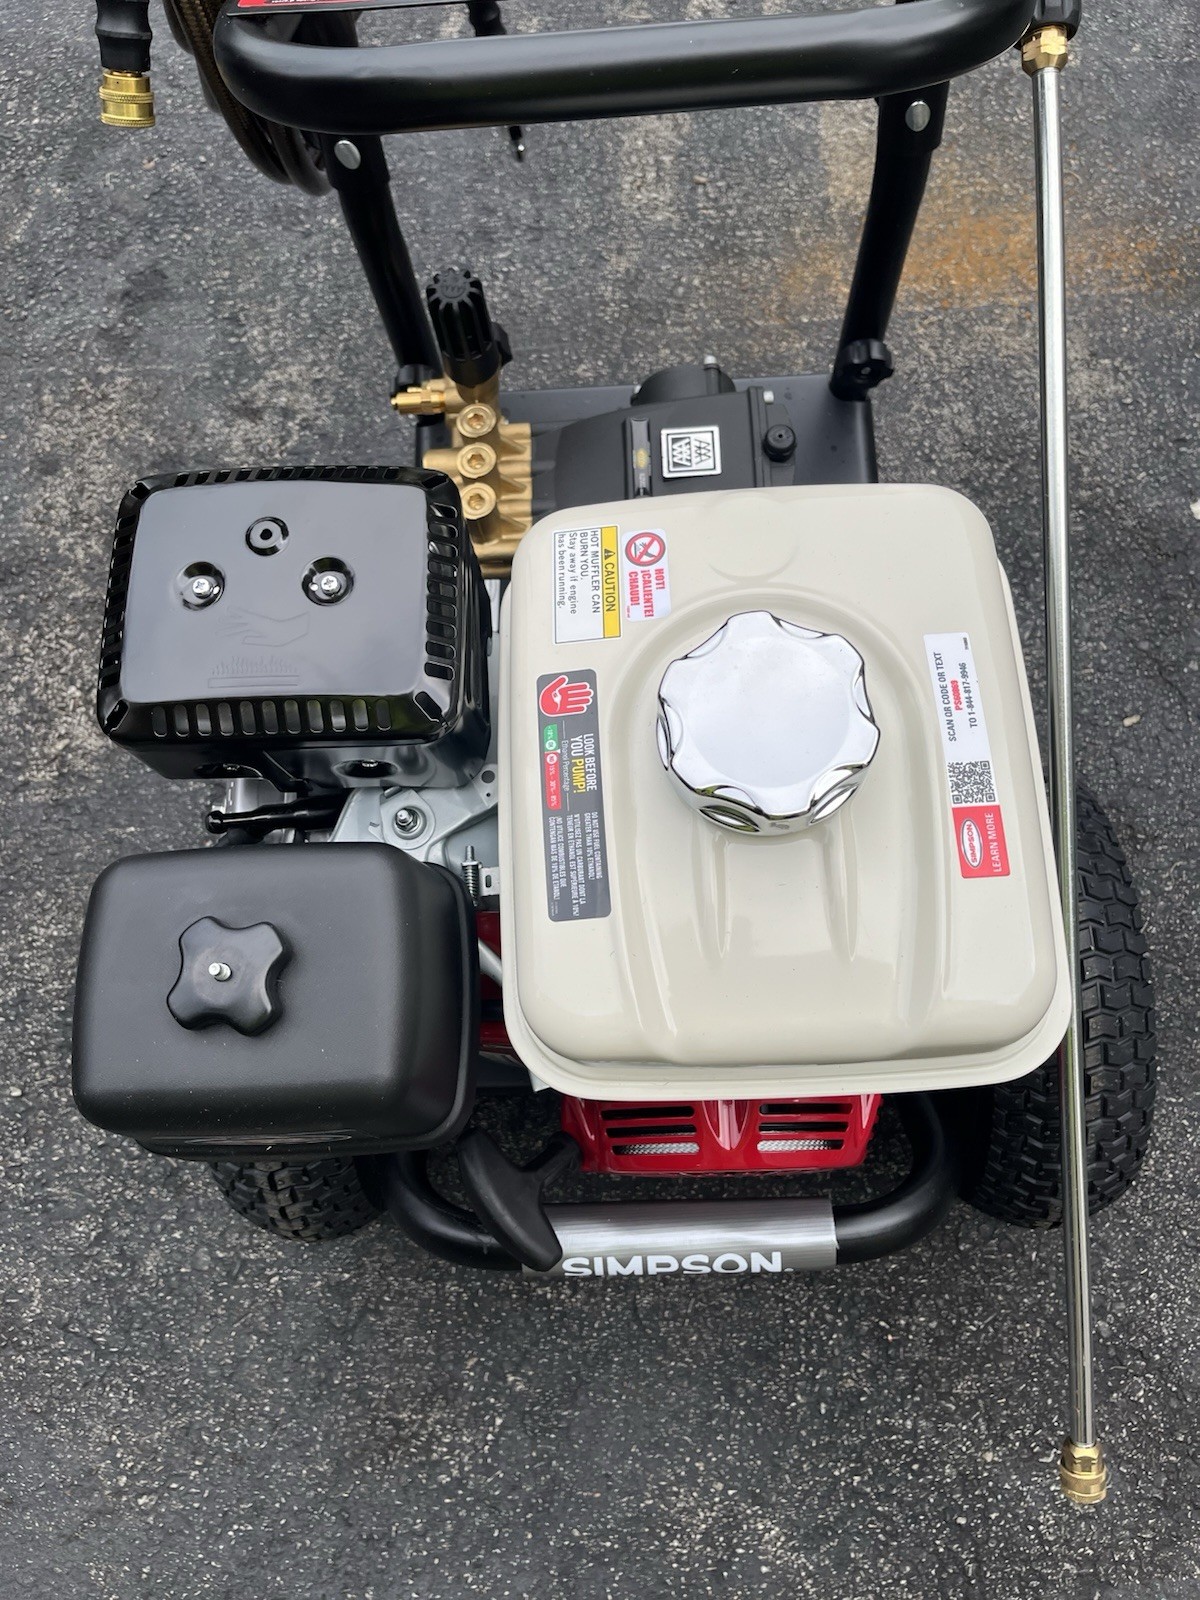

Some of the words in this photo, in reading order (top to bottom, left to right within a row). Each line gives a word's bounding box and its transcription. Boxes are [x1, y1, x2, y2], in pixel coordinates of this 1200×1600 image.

[558, 534, 566, 548] has
[568, 532, 577, 550] Stay
[580, 532, 588, 557] BURN
[591, 530, 599, 547] HOT
[558, 550, 566, 570] been
[568, 552, 576, 573] away
[580, 559, 588, 580] YOU.
[591, 551, 600, 592] MUFFLER
[557, 572, 567, 608] running.
[604, 562, 616, 612] CAUTION
[629, 571, 640, 606] CHAUD!
[655, 568, 665, 589] HOT!
[568, 585, 578, 614] engine
[592, 595, 600, 613] CAN
[933, 652, 944, 670] TEXT
[938, 672, 946, 682] OR
[940, 684, 951, 705] CODE
[959, 662, 975, 716] 1-844-817-9946
[943, 706, 952, 717] QR
[969, 717, 978, 728] TO
[945, 719, 957, 742] SCAN
[561, 740, 569, 760] Ethanol
[570, 735, 584, 756] YOU
[583, 733, 595, 756] LOOK
[562, 761, 570, 792] Percentage
[571, 758, 586, 793] PUMP!
[585, 757, 597, 791] BEFORE
[984, 812, 997, 840] MORE
[966, 823, 977, 864] SIMPSON
[594, 851, 602, 879] CONTAINING
[989, 841, 1002, 872] LEARN
[561, 1251, 783, 1277] SIMPSON
